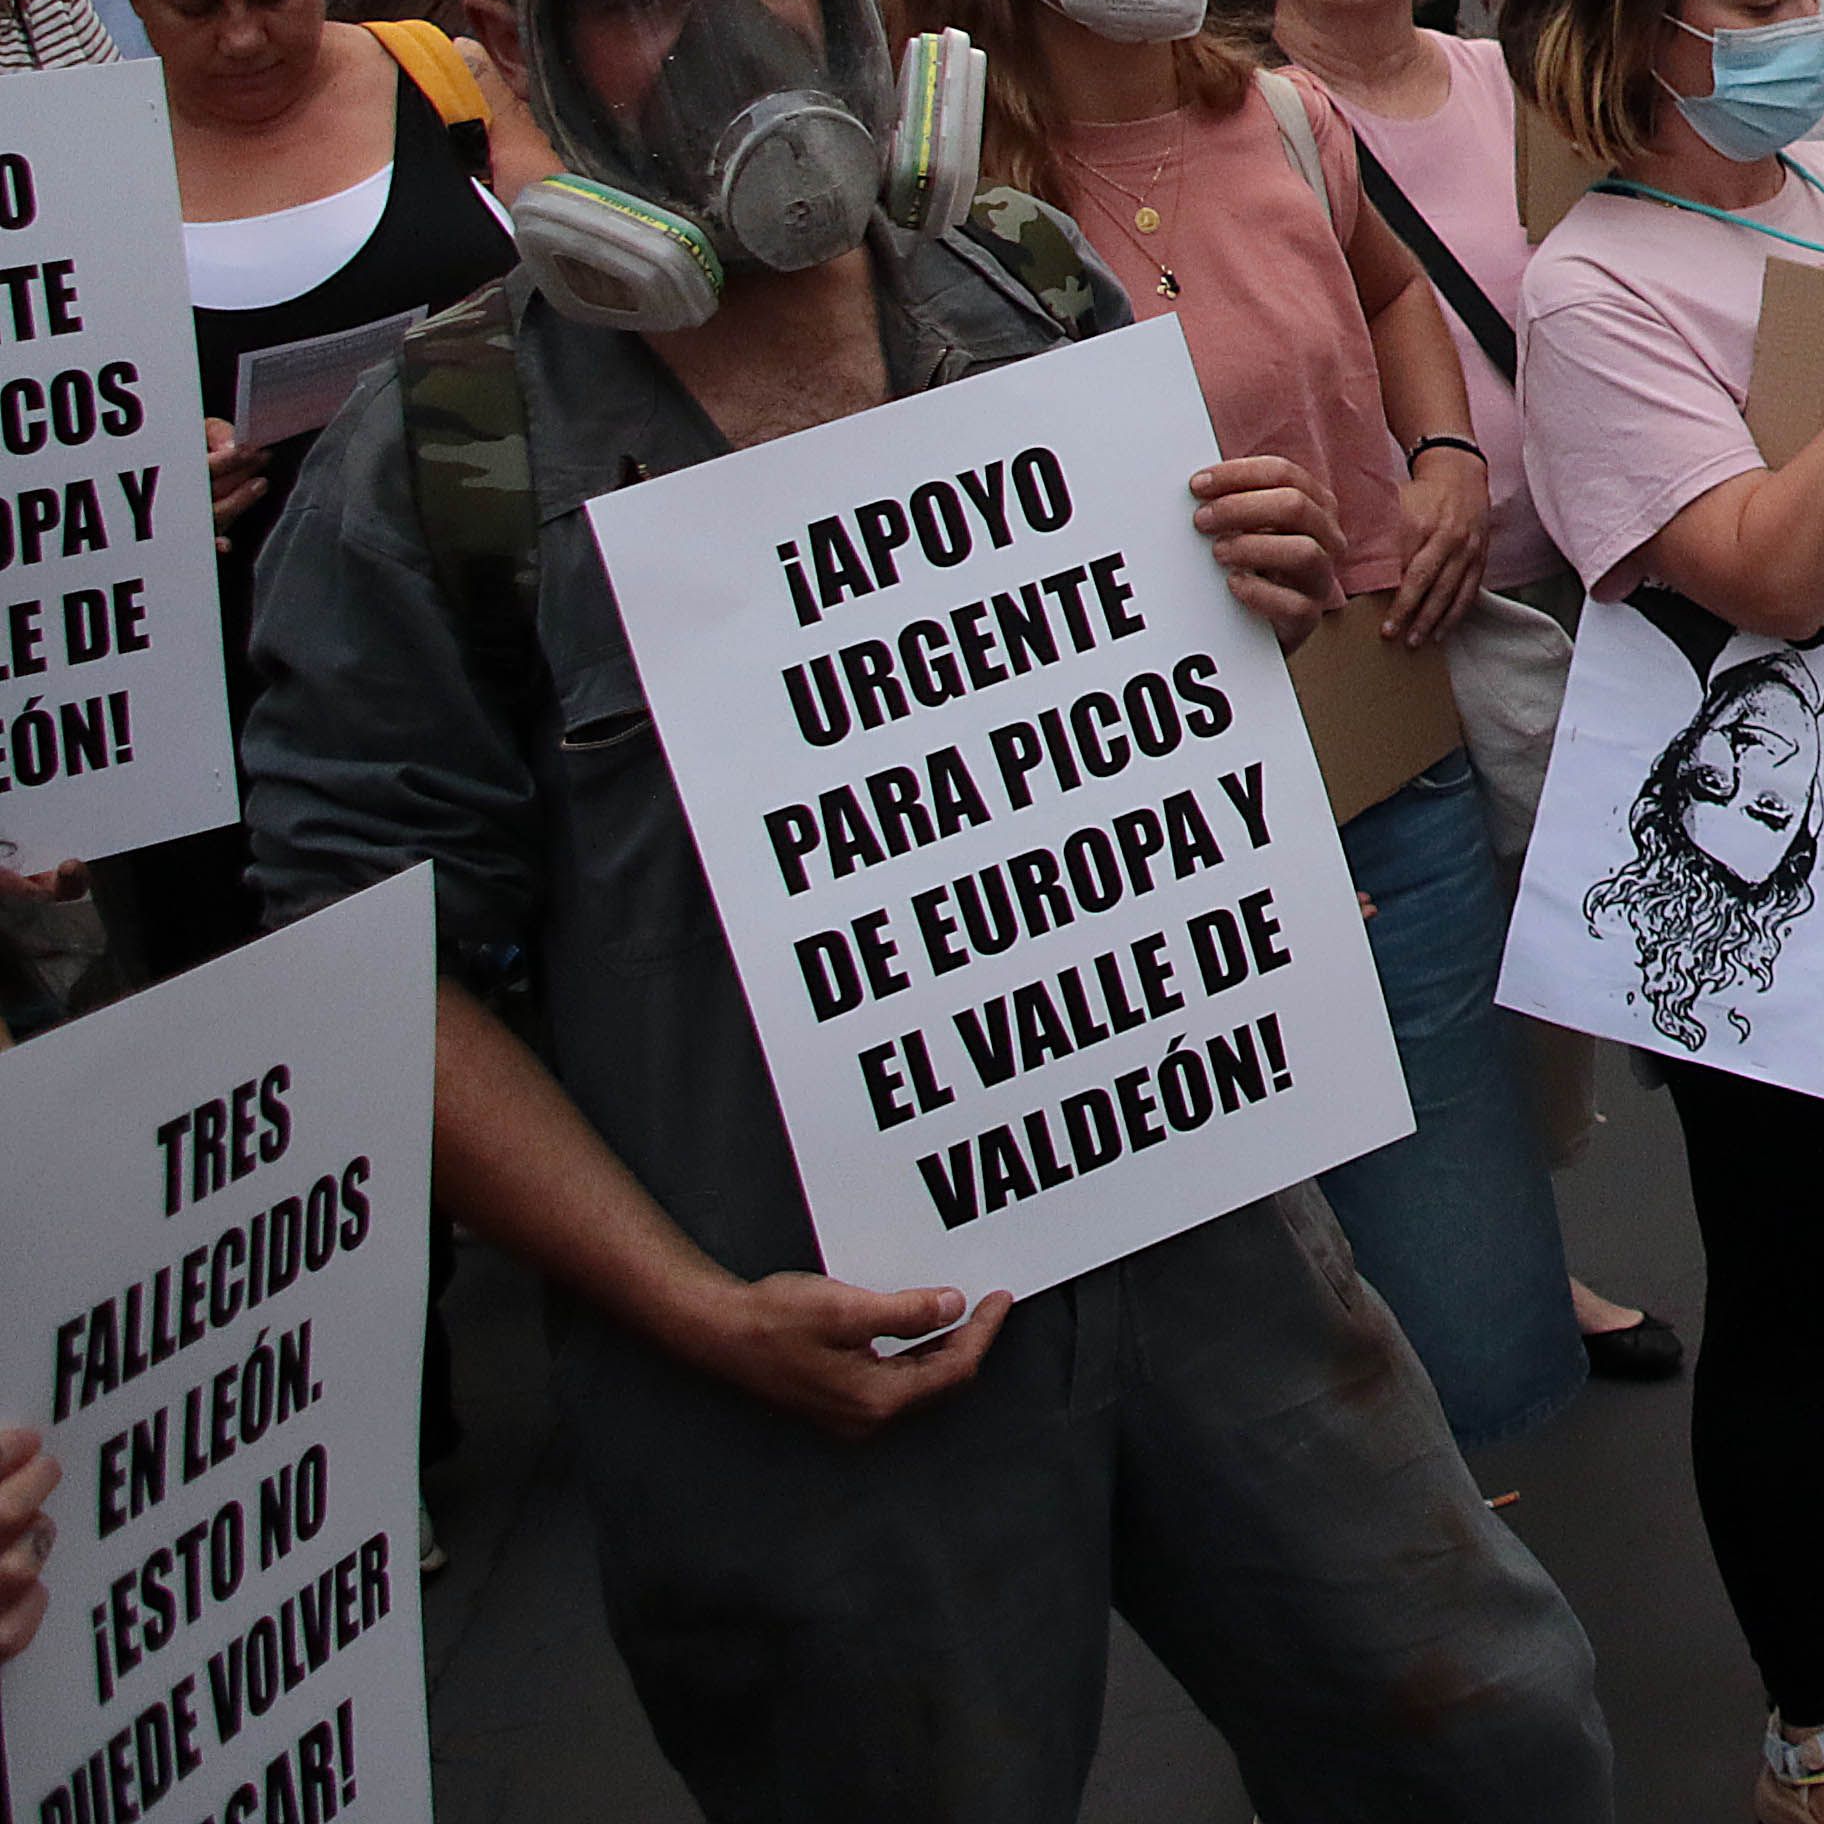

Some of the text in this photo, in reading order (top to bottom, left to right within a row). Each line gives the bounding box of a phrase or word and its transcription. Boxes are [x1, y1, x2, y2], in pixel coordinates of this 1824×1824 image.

[0, 465, 160, 574] PA Y
[63, 577, 151, 667] DE
[776, 445, 1074, 628] ¡APOYO
[0, 690, 136, 793] ÓN!
[781, 550, 1147, 748] URGENTE
[762, 652, 1234, 897] PARA PICOS
[793, 761, 1275, 1024] DE EUROPA Y
[857, 886, 1294, 1133] EL VALLE DE
[157, 1062, 292, 1218] TRES
[915, 1011, 1296, 1232] VALDEÓN!
[51, 1155, 372, 1426] FALLECIDOS
[97, 1317, 324, 1542] EN LEÓN.
[91, 1442, 329, 1706] ¡ESTO NO
[207, 1531, 391, 1746] VOLVER
